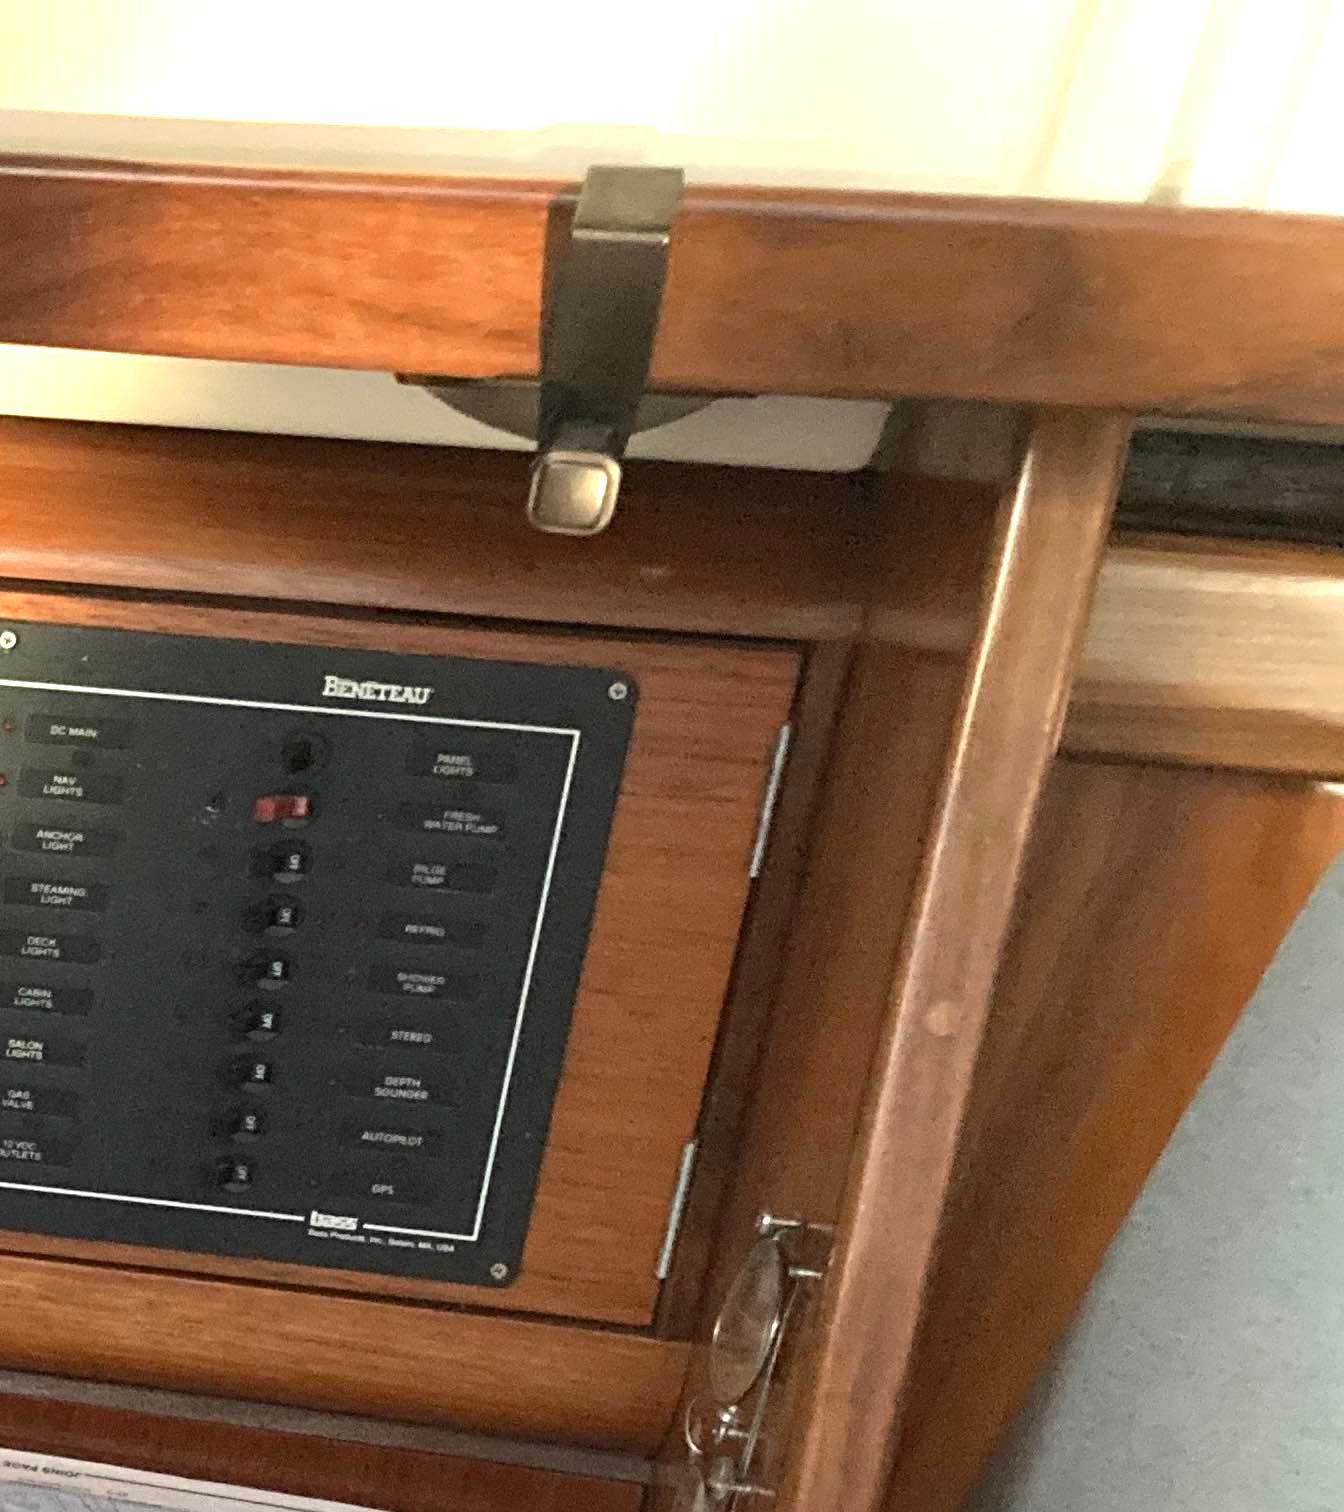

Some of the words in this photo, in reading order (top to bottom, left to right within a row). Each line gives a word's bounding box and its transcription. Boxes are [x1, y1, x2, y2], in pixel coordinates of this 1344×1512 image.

[322, 675, 432, 704] BENETEAU
[50, 724, 66, 736] DC
[68, 726, 97, 739] MAIN
[53, 775, 77, 786] NAV
[43, 784, 83, 797] LIGHTS
[42, 840, 75, 851] LIGHT
[31, 883, 87, 897] STEAMING
[40, 894, 74, 906] LIGHT
[26, 935, 56, 947] DECK
[20, 945, 60, 958] LIGHTS
[17, 986, 52, 999] CABIN
[14, 996, 53, 1009] LIGHTS
[391, 1029, 433, 1044] STEREO
[8, 1039, 44, 1051] SALON
[5, 1048, 43, 1061] LIGHTS
[384, 1076, 421, 1089] DEPTH
[7, 1089, 31, 1100] GAS
[361, 1131, 423, 1147] AUTOPILOT
[371, 1183, 395, 1196] GPS
[3, 1459, 39, 1472] PAGE
